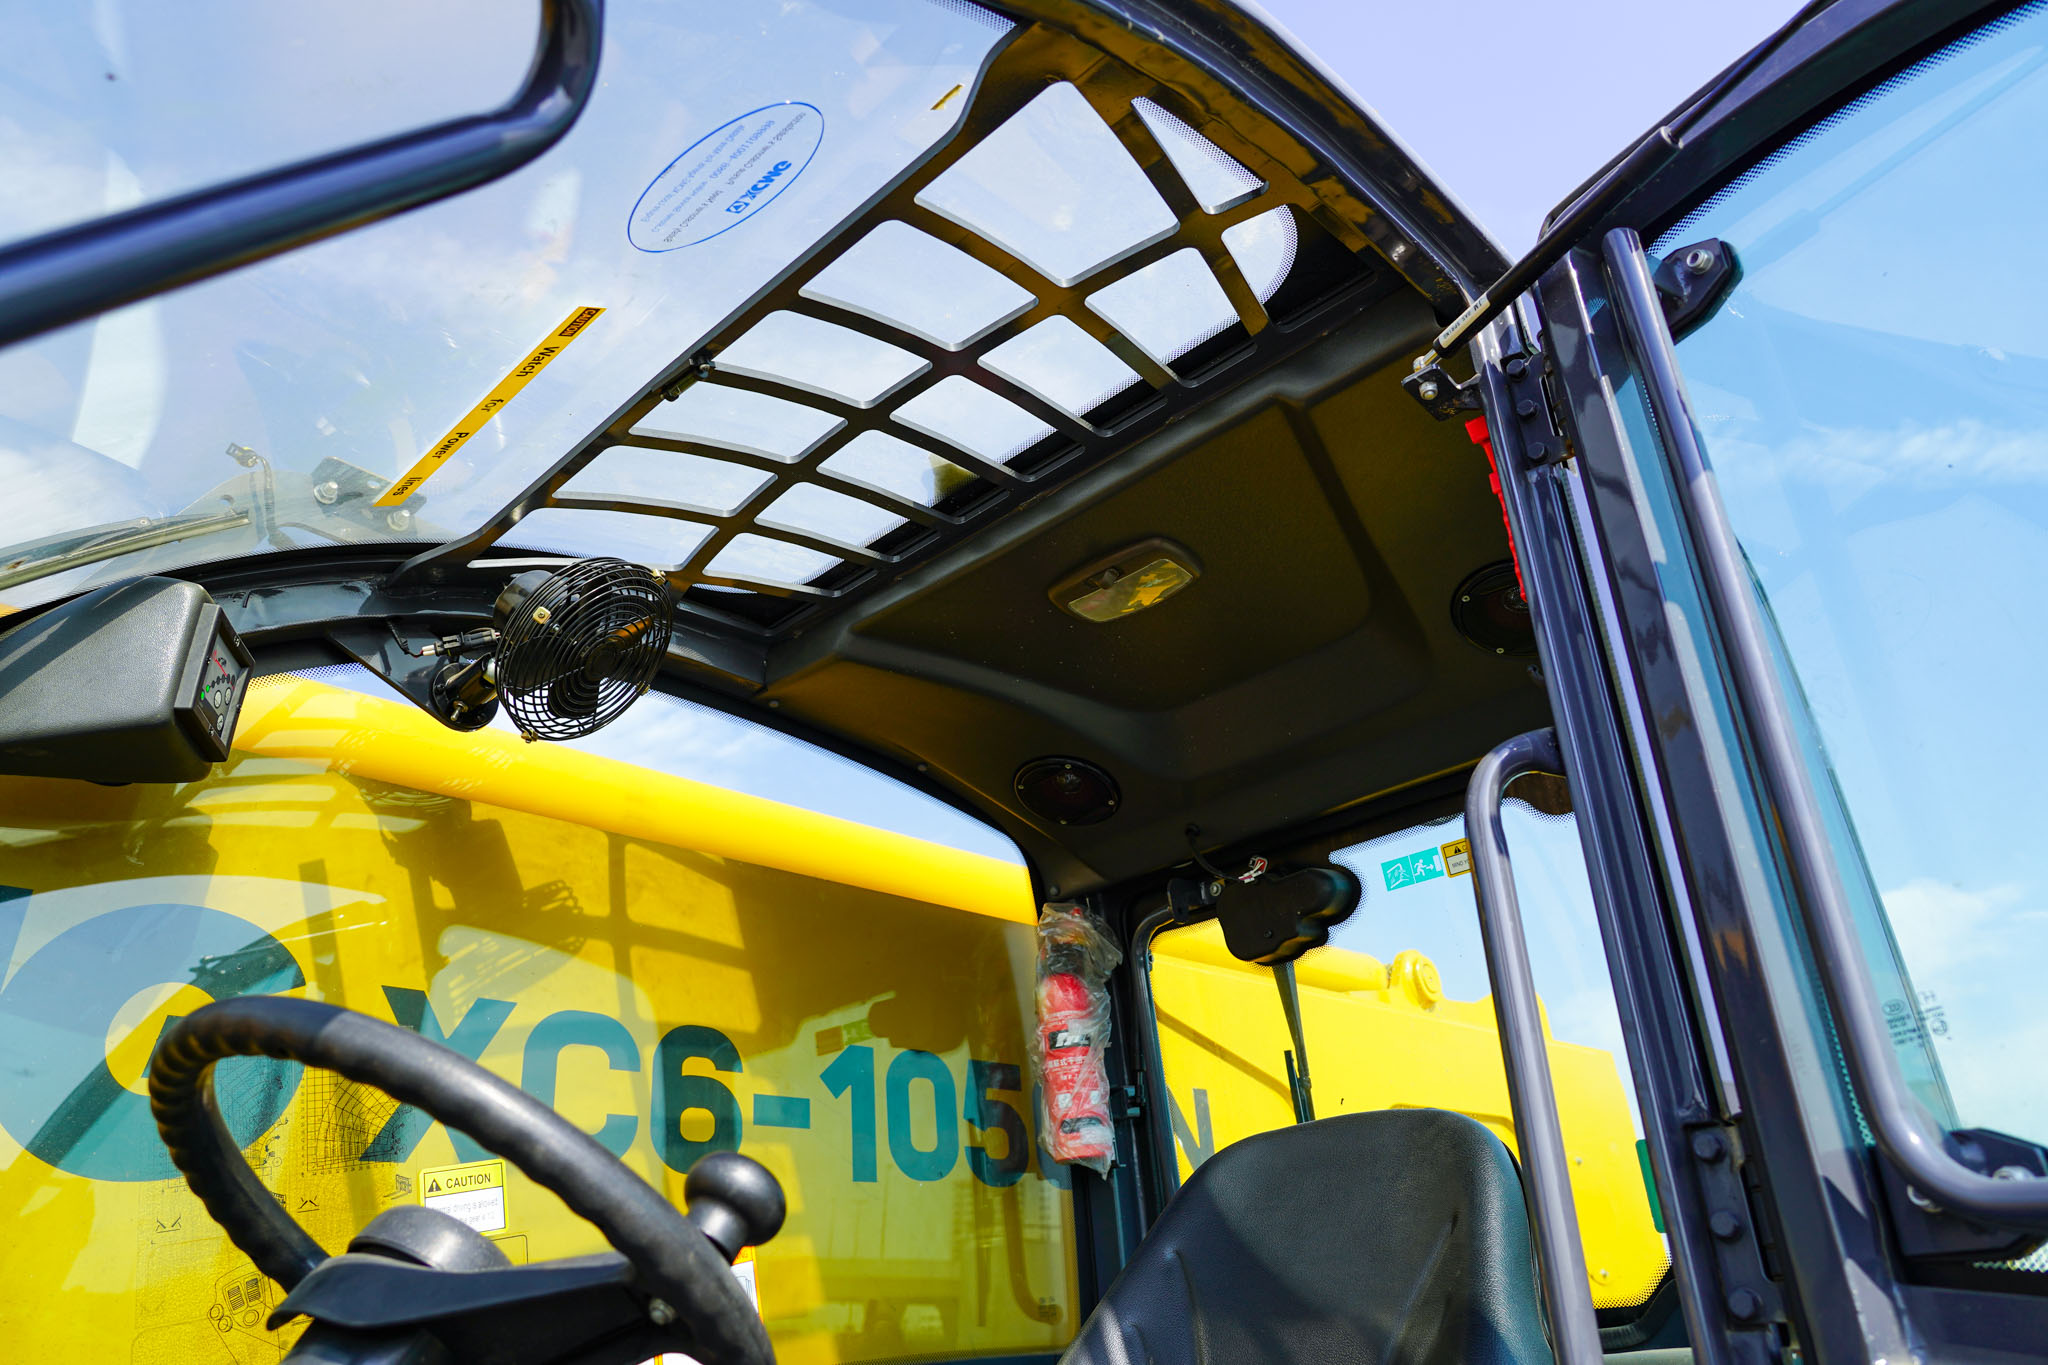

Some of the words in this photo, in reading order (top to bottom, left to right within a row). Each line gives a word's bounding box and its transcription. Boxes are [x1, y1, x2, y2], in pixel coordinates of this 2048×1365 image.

[562, 309, 597, 336] CAUTION
[516, 346, 559, 377] Watch
[481, 398, 504, 413] for
[432, 432, 469, 459] Power
[392, 476, 423, 497] lines
[446, 1173, 491, 1189] CAUTION
